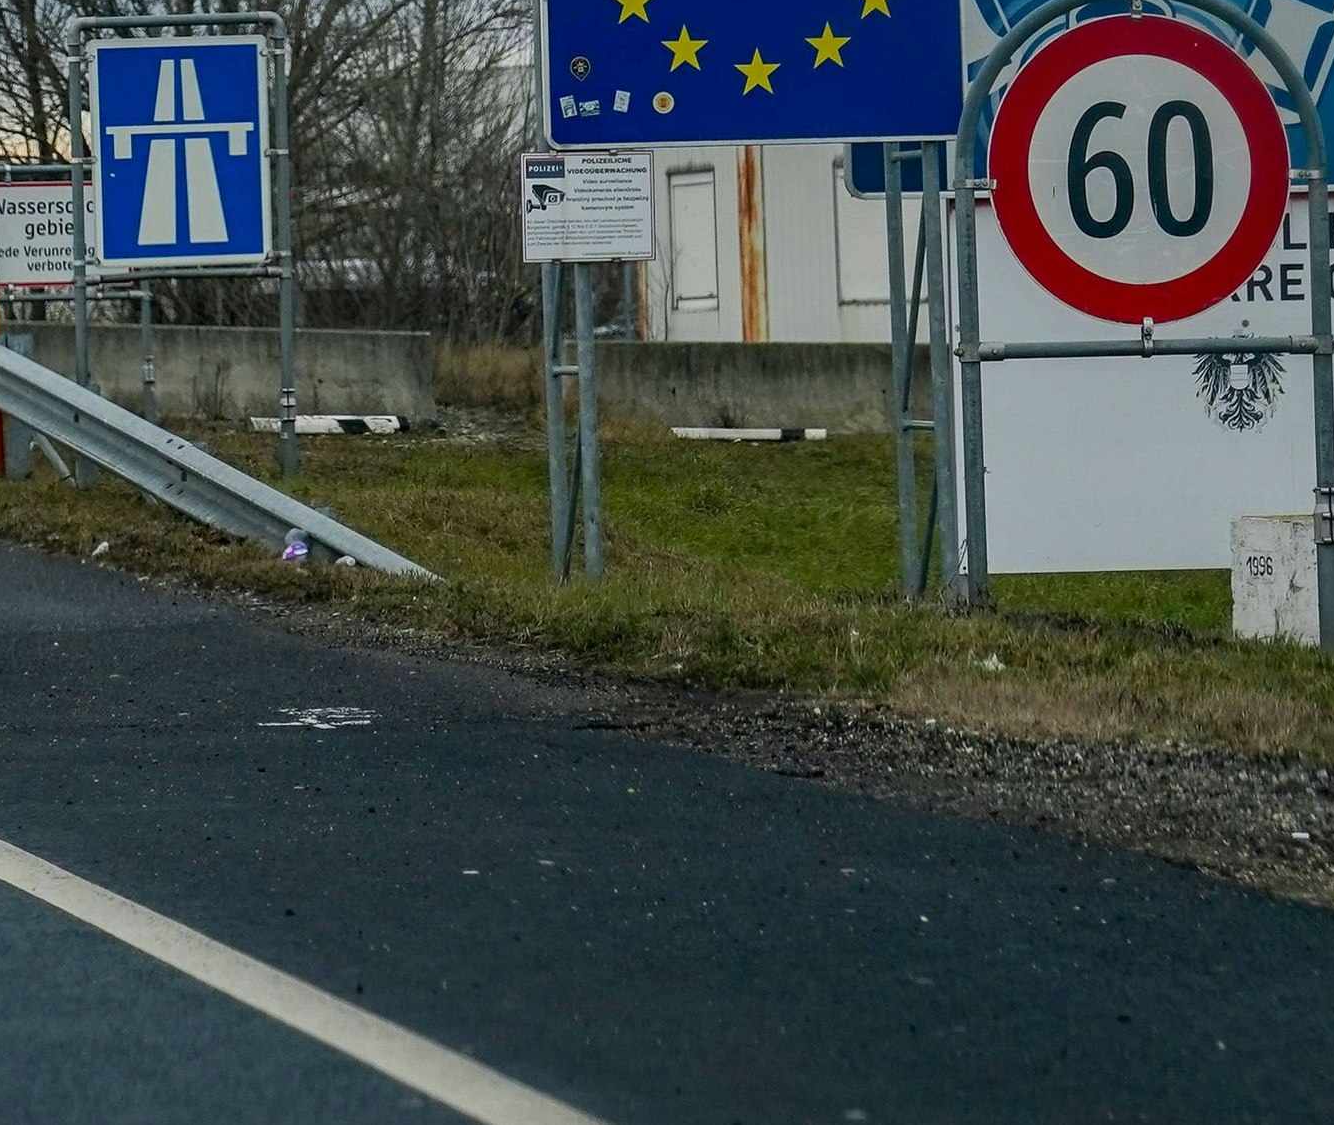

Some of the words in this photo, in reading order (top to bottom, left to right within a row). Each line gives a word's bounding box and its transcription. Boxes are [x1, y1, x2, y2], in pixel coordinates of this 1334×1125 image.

[528, 164, 559, 174] POLIZEI
[581, 157, 633, 165] POLIZEILICHE
[1068, 100, 1214, 238] 60
[25, 218, 74, 240] gebie
[27, 259, 74, 272] verbote
[1246, 555, 1274, 577] 1996
